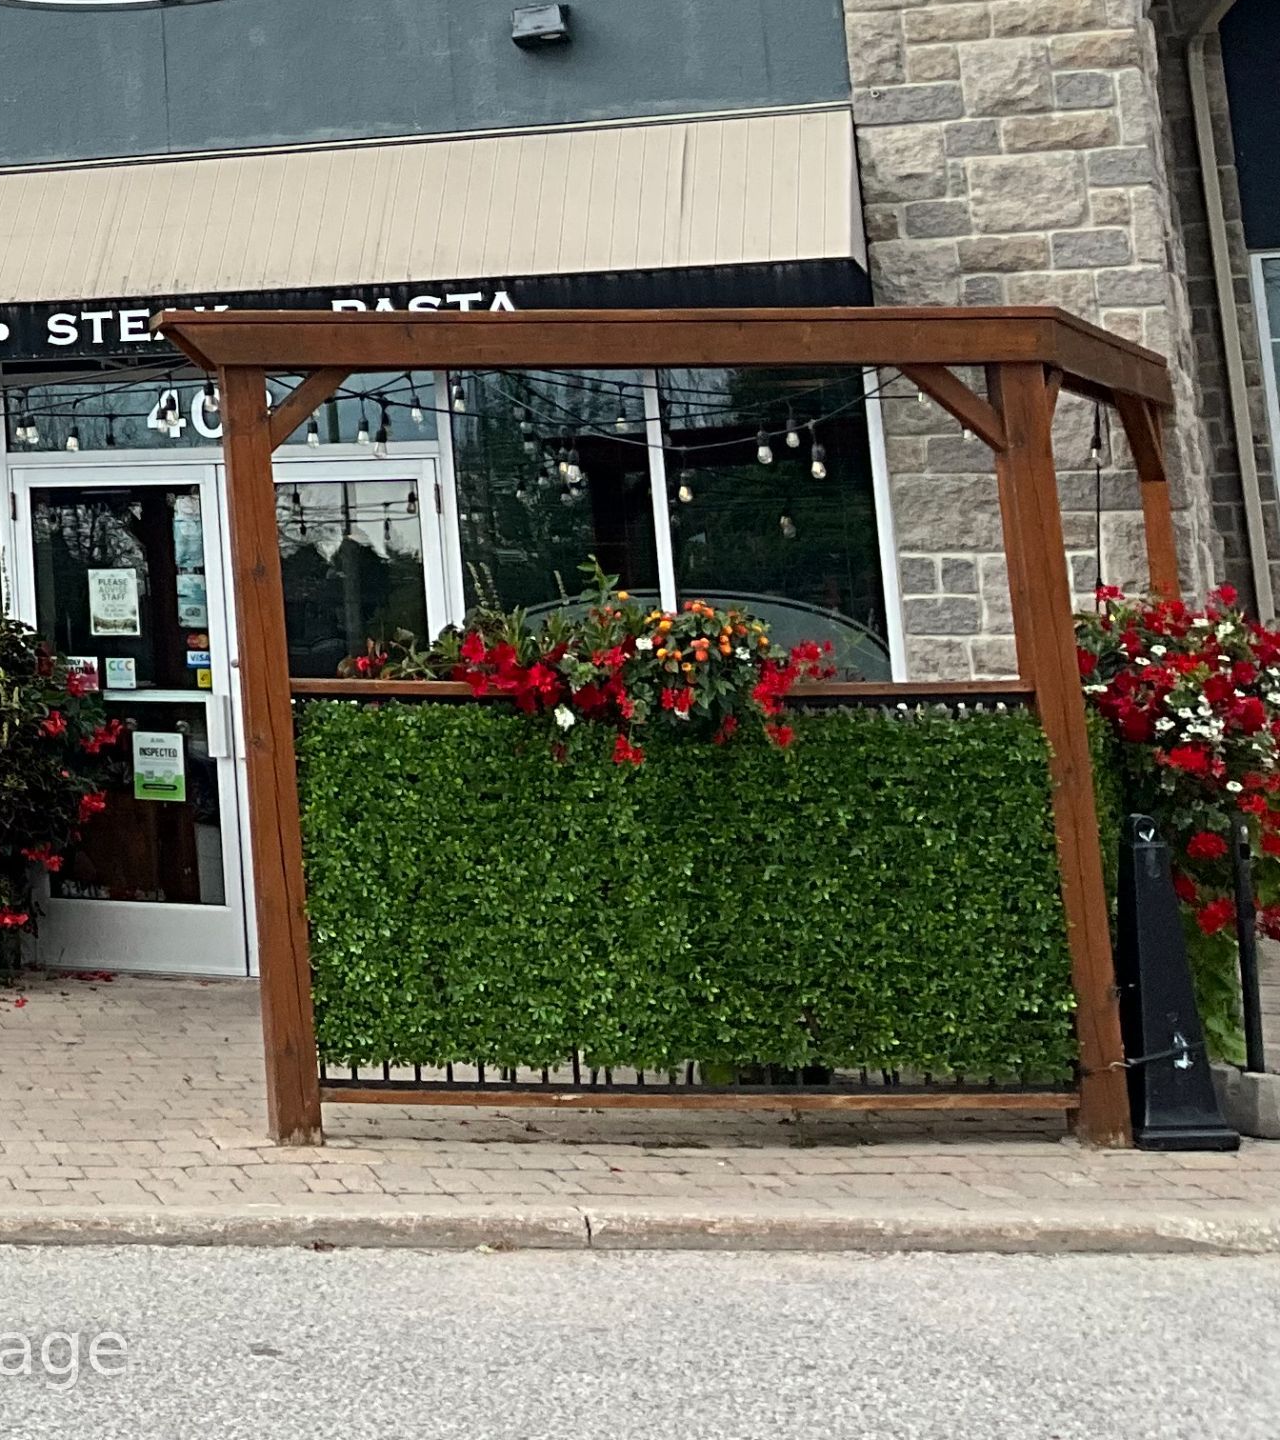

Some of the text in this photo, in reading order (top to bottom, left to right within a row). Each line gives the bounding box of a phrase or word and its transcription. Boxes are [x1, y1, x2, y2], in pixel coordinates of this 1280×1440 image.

[47, 304, 229, 346] STE
[147, 389, 273, 438] 40
[190, 653, 211, 662] VISA
[108, 660, 133, 671] CCC
[139, 747, 178, 758] INSPECTED
